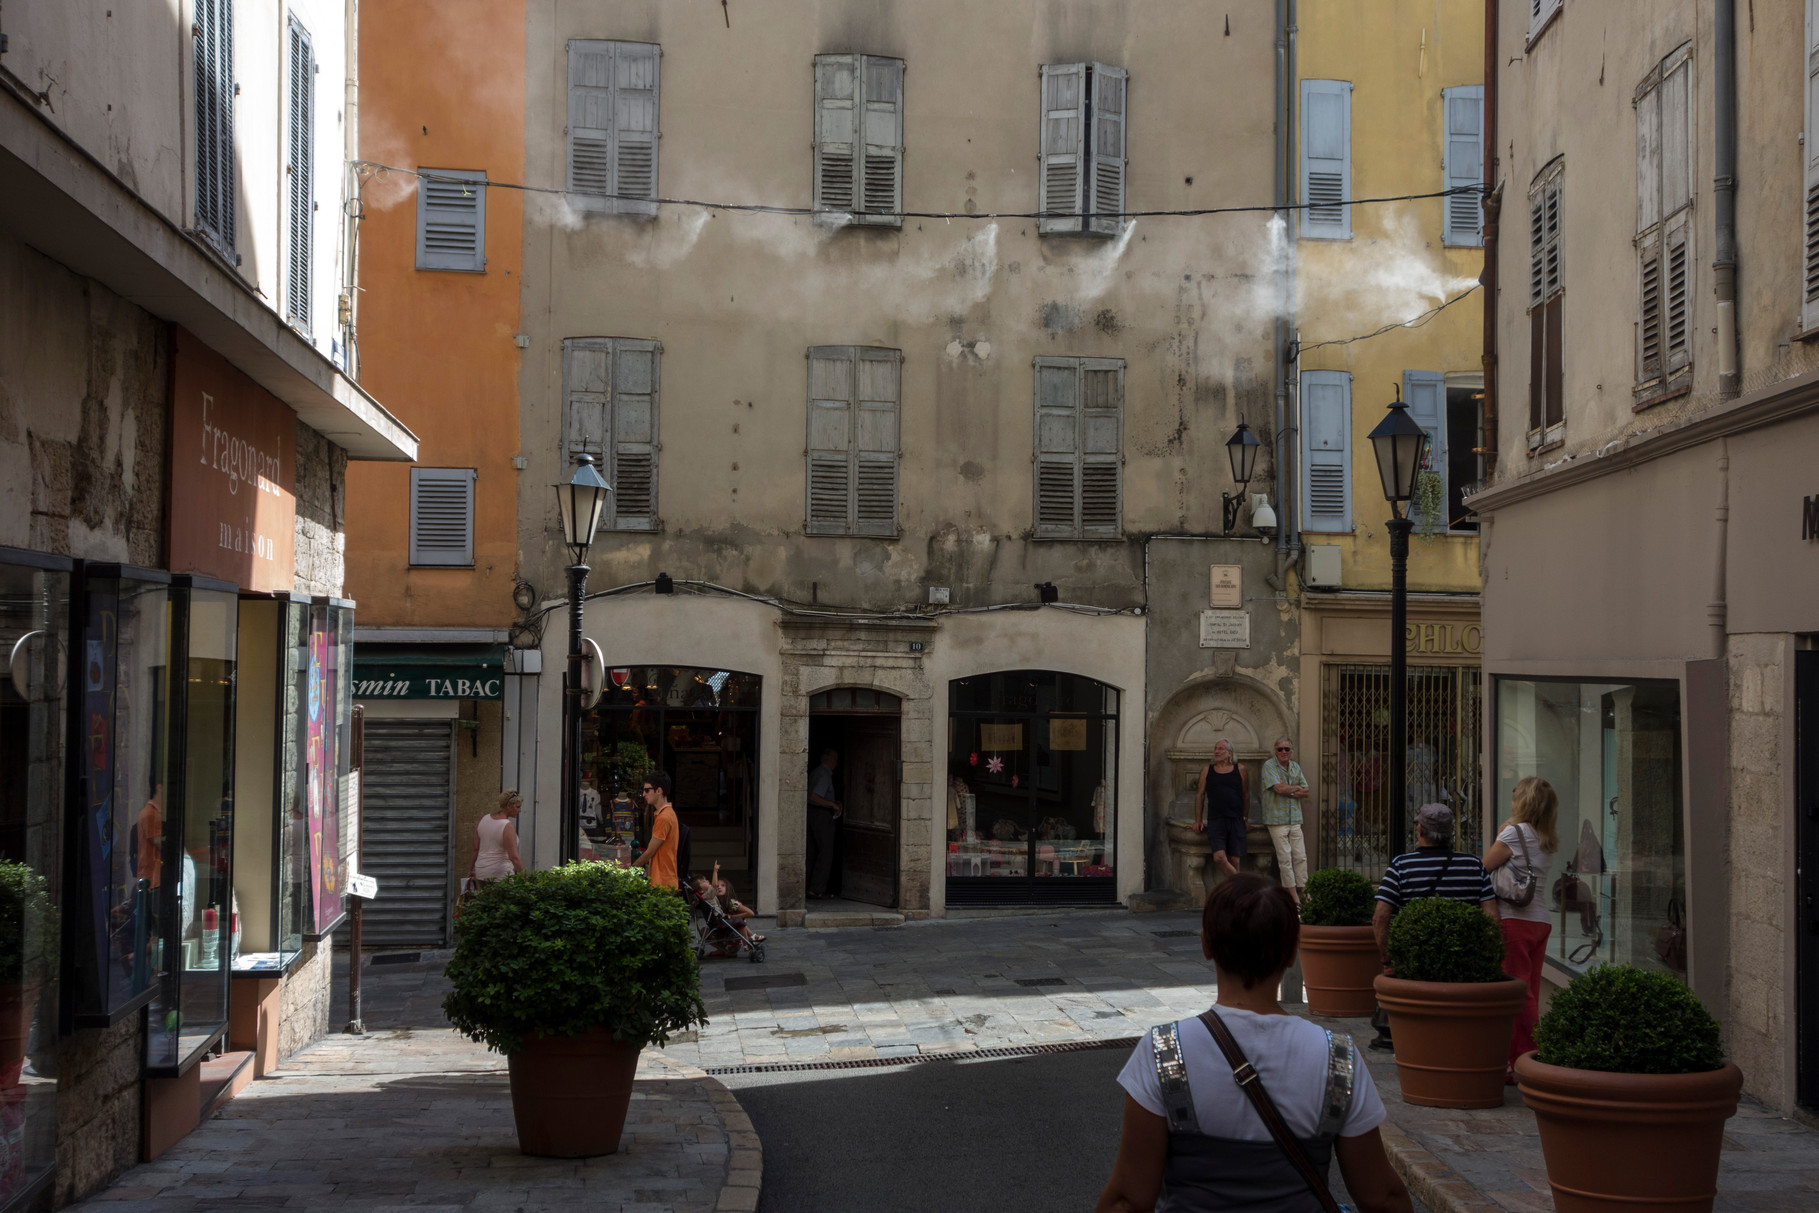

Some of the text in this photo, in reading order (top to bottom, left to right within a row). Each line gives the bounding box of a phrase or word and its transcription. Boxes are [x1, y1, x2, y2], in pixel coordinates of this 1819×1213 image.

[200, 391, 281, 497] Fragonard
[218, 517, 274, 561] maison
[912, 642, 921, 651] 10
[425, 678, 500, 697] TABAC
